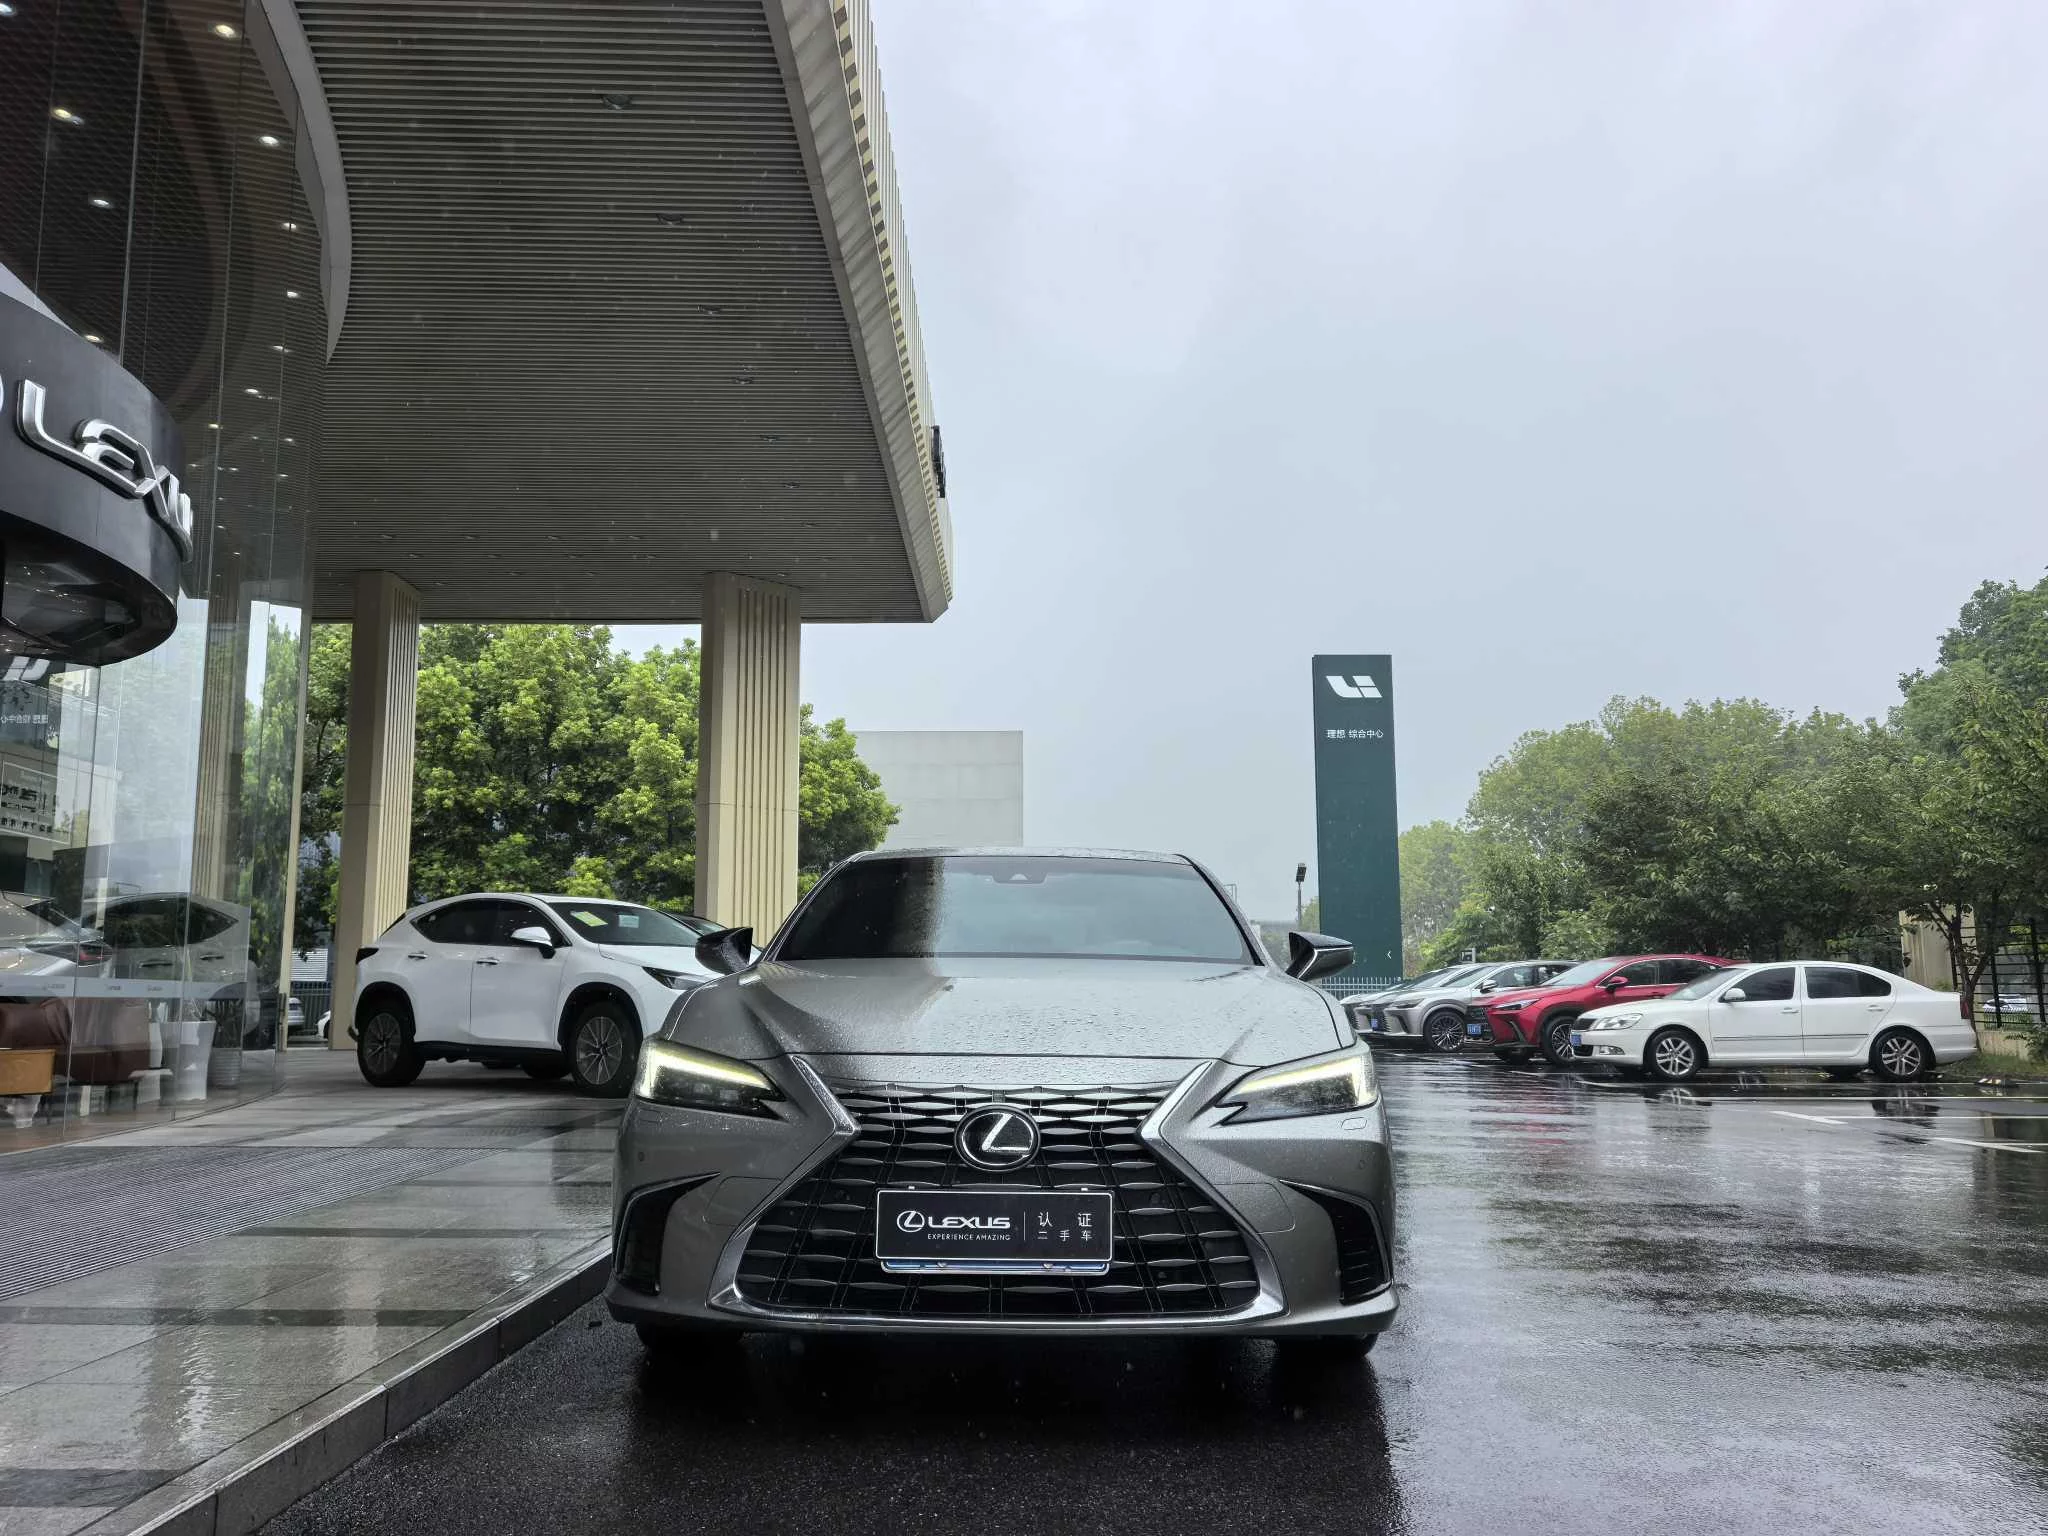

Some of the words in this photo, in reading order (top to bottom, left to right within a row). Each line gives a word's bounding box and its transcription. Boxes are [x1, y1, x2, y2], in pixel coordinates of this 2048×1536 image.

[16, 378, 194, 563] LEXU
[1326, 729, 1346, 739] 理想
[1348, 729, 1384, 739] 综合中心
[928, 1216, 1011, 1229] LEXUS
[1037, 1211, 1093, 1228] 认证
[927, 1233, 974, 1241] EXPERIENCE
[1037, 1229, 1093, 1242] 二手车
